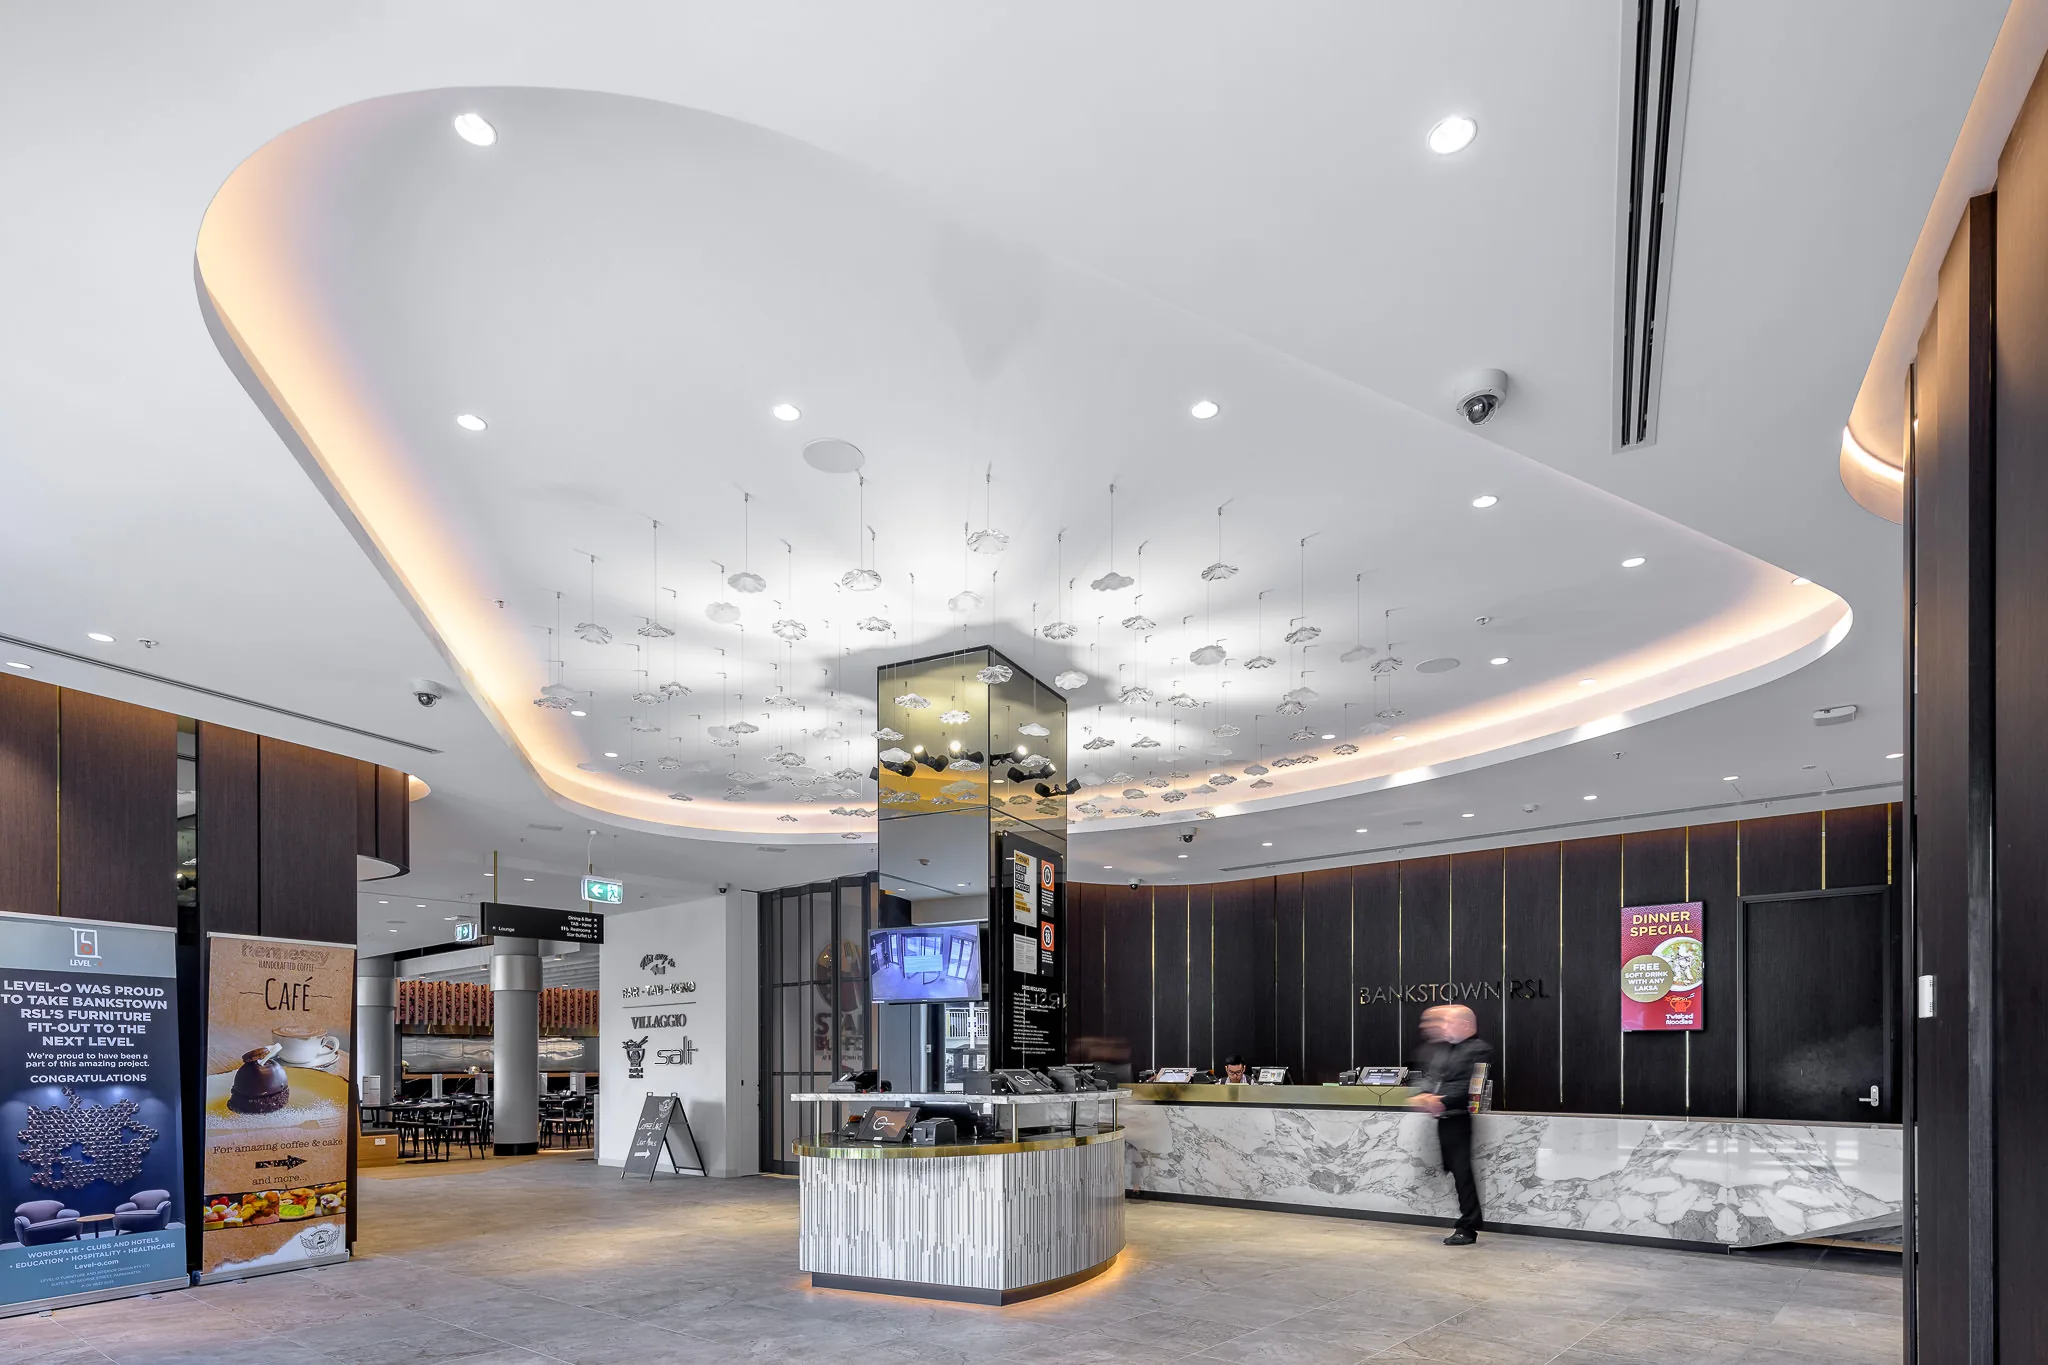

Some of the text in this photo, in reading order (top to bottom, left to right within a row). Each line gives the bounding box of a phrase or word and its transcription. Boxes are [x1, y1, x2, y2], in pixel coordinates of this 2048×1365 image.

[1633, 911, 1690, 925] DINNER
[1630, 924, 1693, 937] SPECIAL
[70, 959, 92, 967] LEVEL
[258, 960, 314, 972] HANDCRAFTED COFFEE
[1633, 963, 1659, 971] FREE
[3, 980, 164, 997] LEVEL-O WAS PROUD
[1360, 979, 1550, 1005] BANKSTOWN RSL
[0, 994, 168, 1010] TO TAKE BANKSTOWN
[20, 1008, 152, 1022] RSL'S FURNITURE
[631, 1013, 687, 1029] VILLAGGIO
[1665, 1013, 1694, 1021] Twisted
[27, 1022, 146, 1034] FIT-OUT TO THE
[42, 1036, 135, 1047] NEXT LEVEL
[654, 1035, 692, 1065] salt
[26, 1052, 55, 1060] We're
[56, 1052, 84, 1061] proud
[98, 1052, 119, 1060] have
[120, 1052, 141, 1060] been
[25, 1061, 46, 1069] part
[78, 1060, 116, 1068] amazing
[118, 1060, 150, 1069] project.
[30, 1074, 147, 1083] CONGRATULATIONS
[213, 1138, 343, 1154] For amazing coffee & cake
[252, 1174, 307, 1185] and more...
[27, 1247, 79, 1259] WORKSPACE
[86, 1242, 112, 1251] CLUBS
[131, 1237, 160, 1246] HOTELS
[15, 1243, 176, 1269] EDUCATION HOSPITALITY HEALTHCARE
[74, 1259, 119, 1270] Level-o.com
